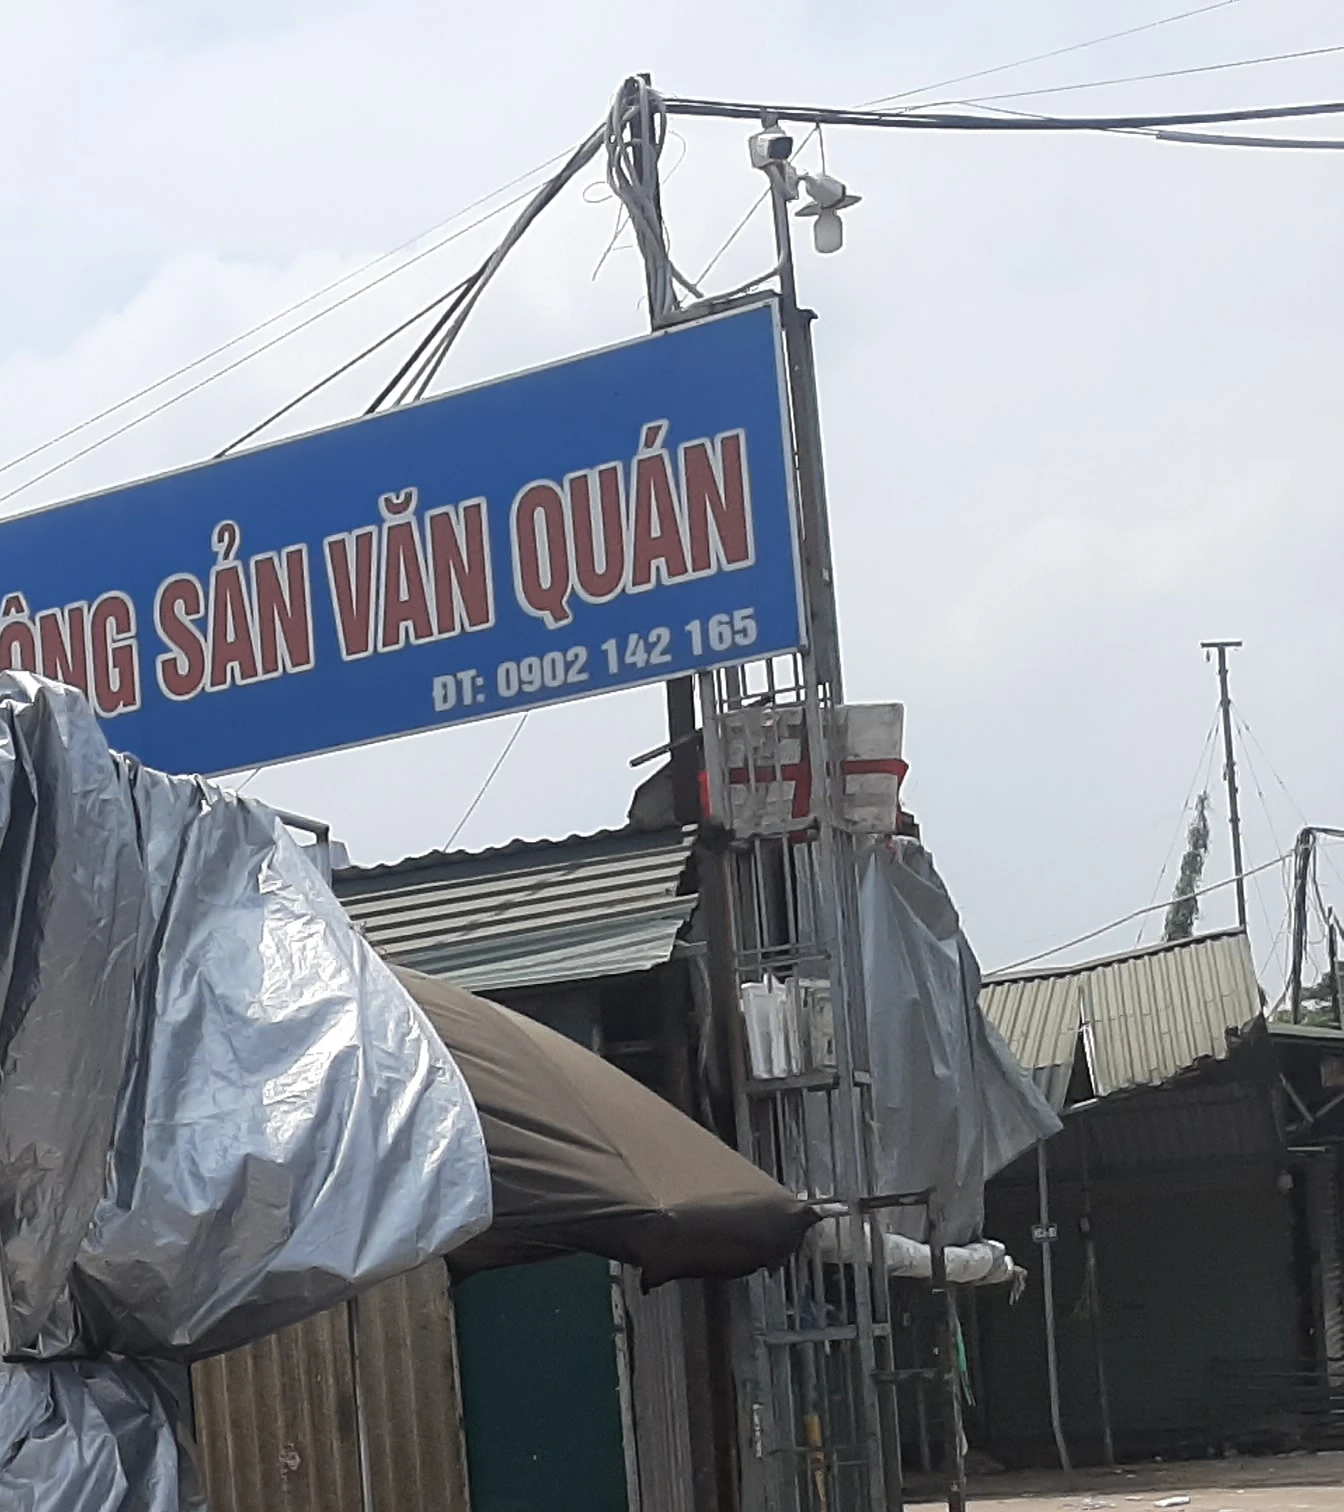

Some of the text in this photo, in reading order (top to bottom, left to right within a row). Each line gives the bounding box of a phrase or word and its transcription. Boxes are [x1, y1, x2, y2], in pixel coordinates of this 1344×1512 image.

[154, 519, 315, 702] SẢN
[325, 487, 496, 662] VĂN
[511, 418, 755, 630] QUÁN
[433, 607, 758, 712] ĐT: 0902 142 165
